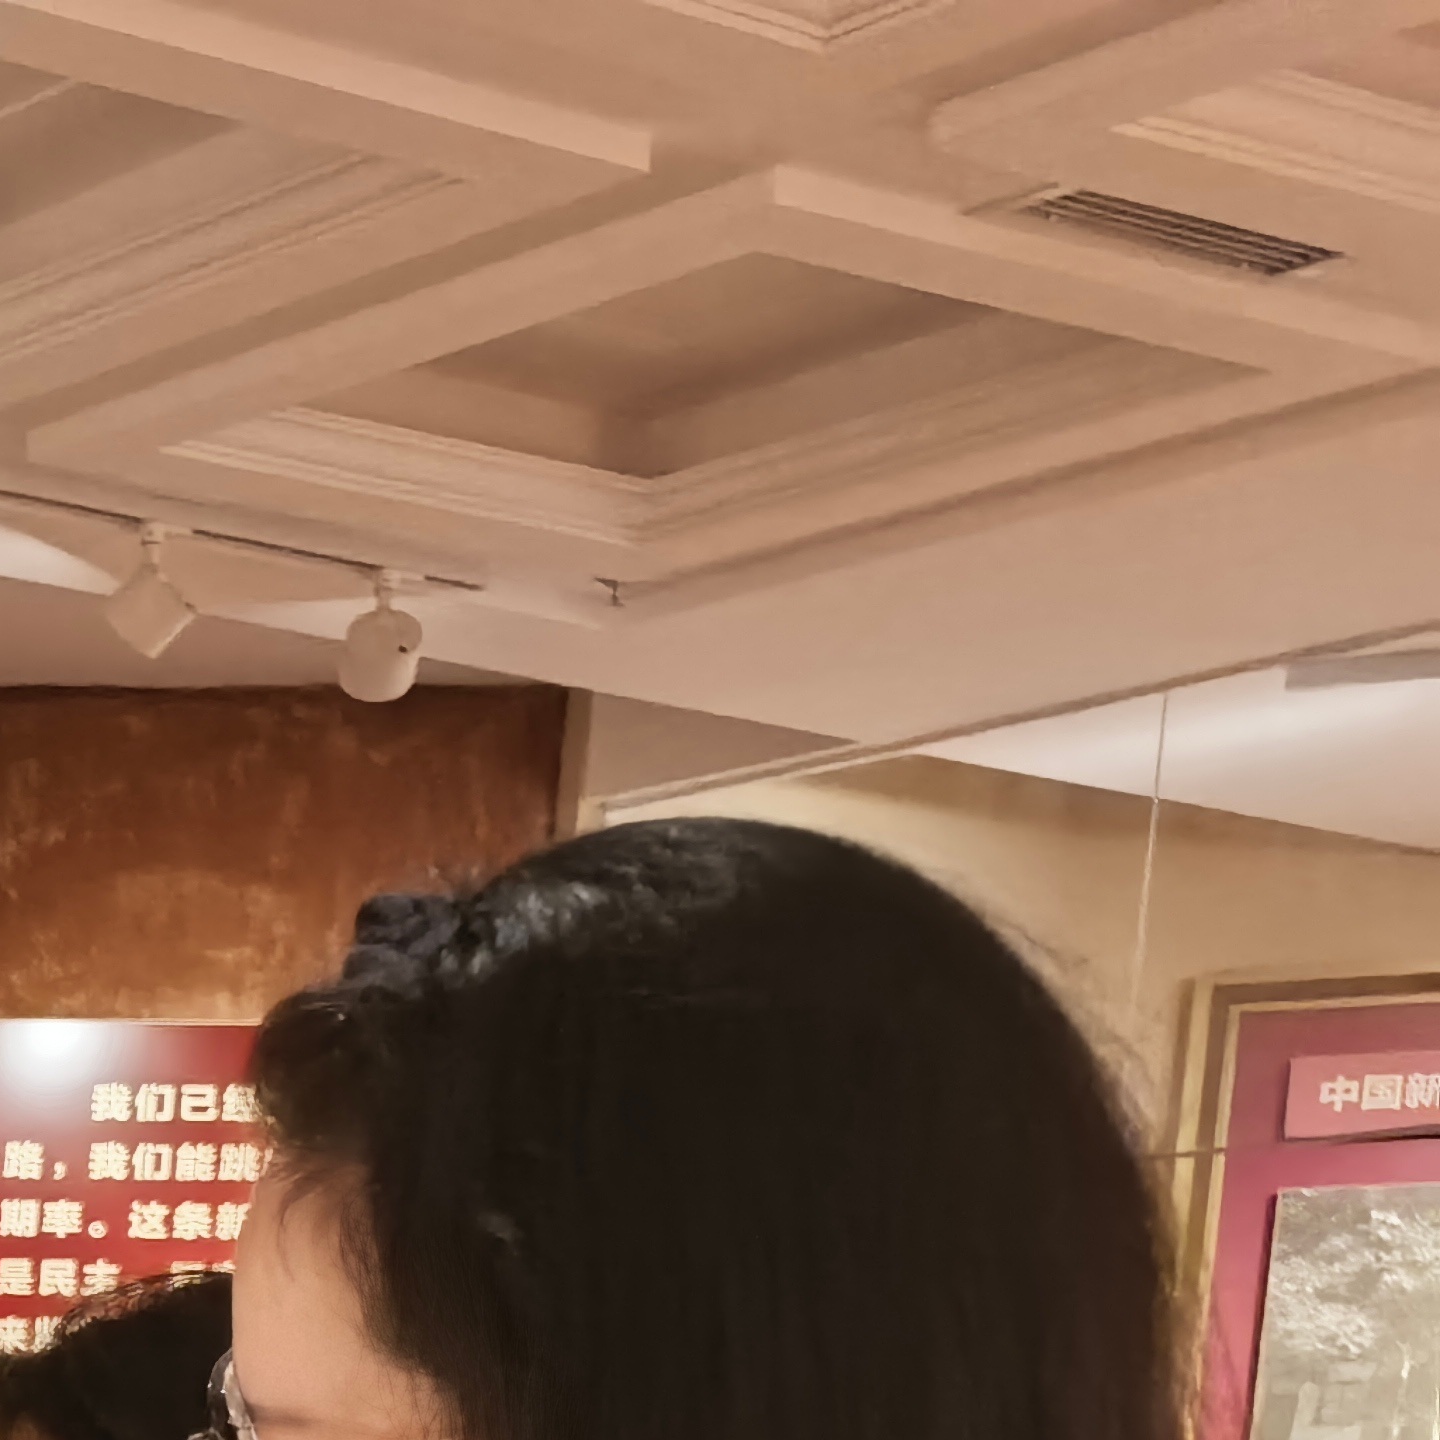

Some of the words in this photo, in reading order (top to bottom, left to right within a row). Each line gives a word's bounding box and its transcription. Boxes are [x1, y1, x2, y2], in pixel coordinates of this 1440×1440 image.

[90, 1082, 260, 1123] 我们已经
[0, 1140, 273, 1183] 路，我们能跳
